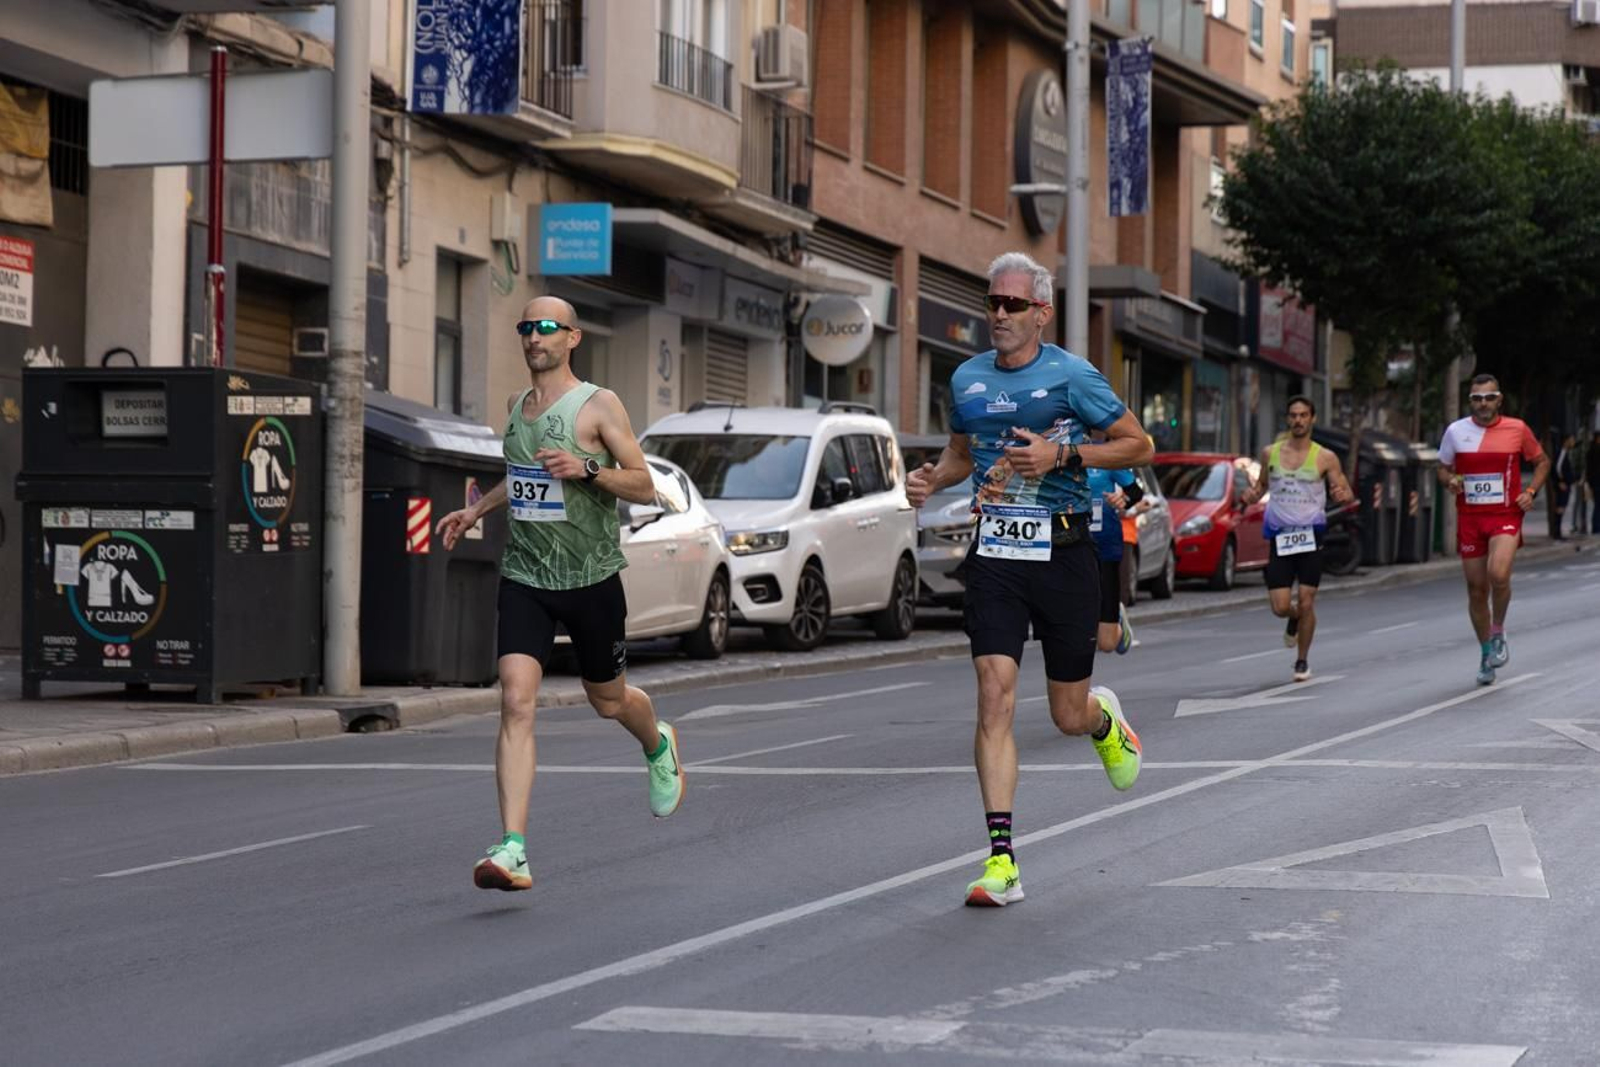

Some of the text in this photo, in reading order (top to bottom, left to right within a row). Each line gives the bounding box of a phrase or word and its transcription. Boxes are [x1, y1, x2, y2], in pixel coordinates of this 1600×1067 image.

[435, 12, 450, 55] JUAN
[547, 217, 600, 232] endesa
[114, 398, 165, 410] DEPOSITAR
[106, 415, 140, 426] BOLSAS
[257, 430, 281, 446] ROPA
[512, 480, 550, 501] 937
[1474, 482, 1492, 493] 60
[992, 518, 1037, 541] 340
[1283, 533, 1307, 545] 700
[97, 544, 139, 561] ROPA
[85, 610, 149, 624] Y CALZADO
